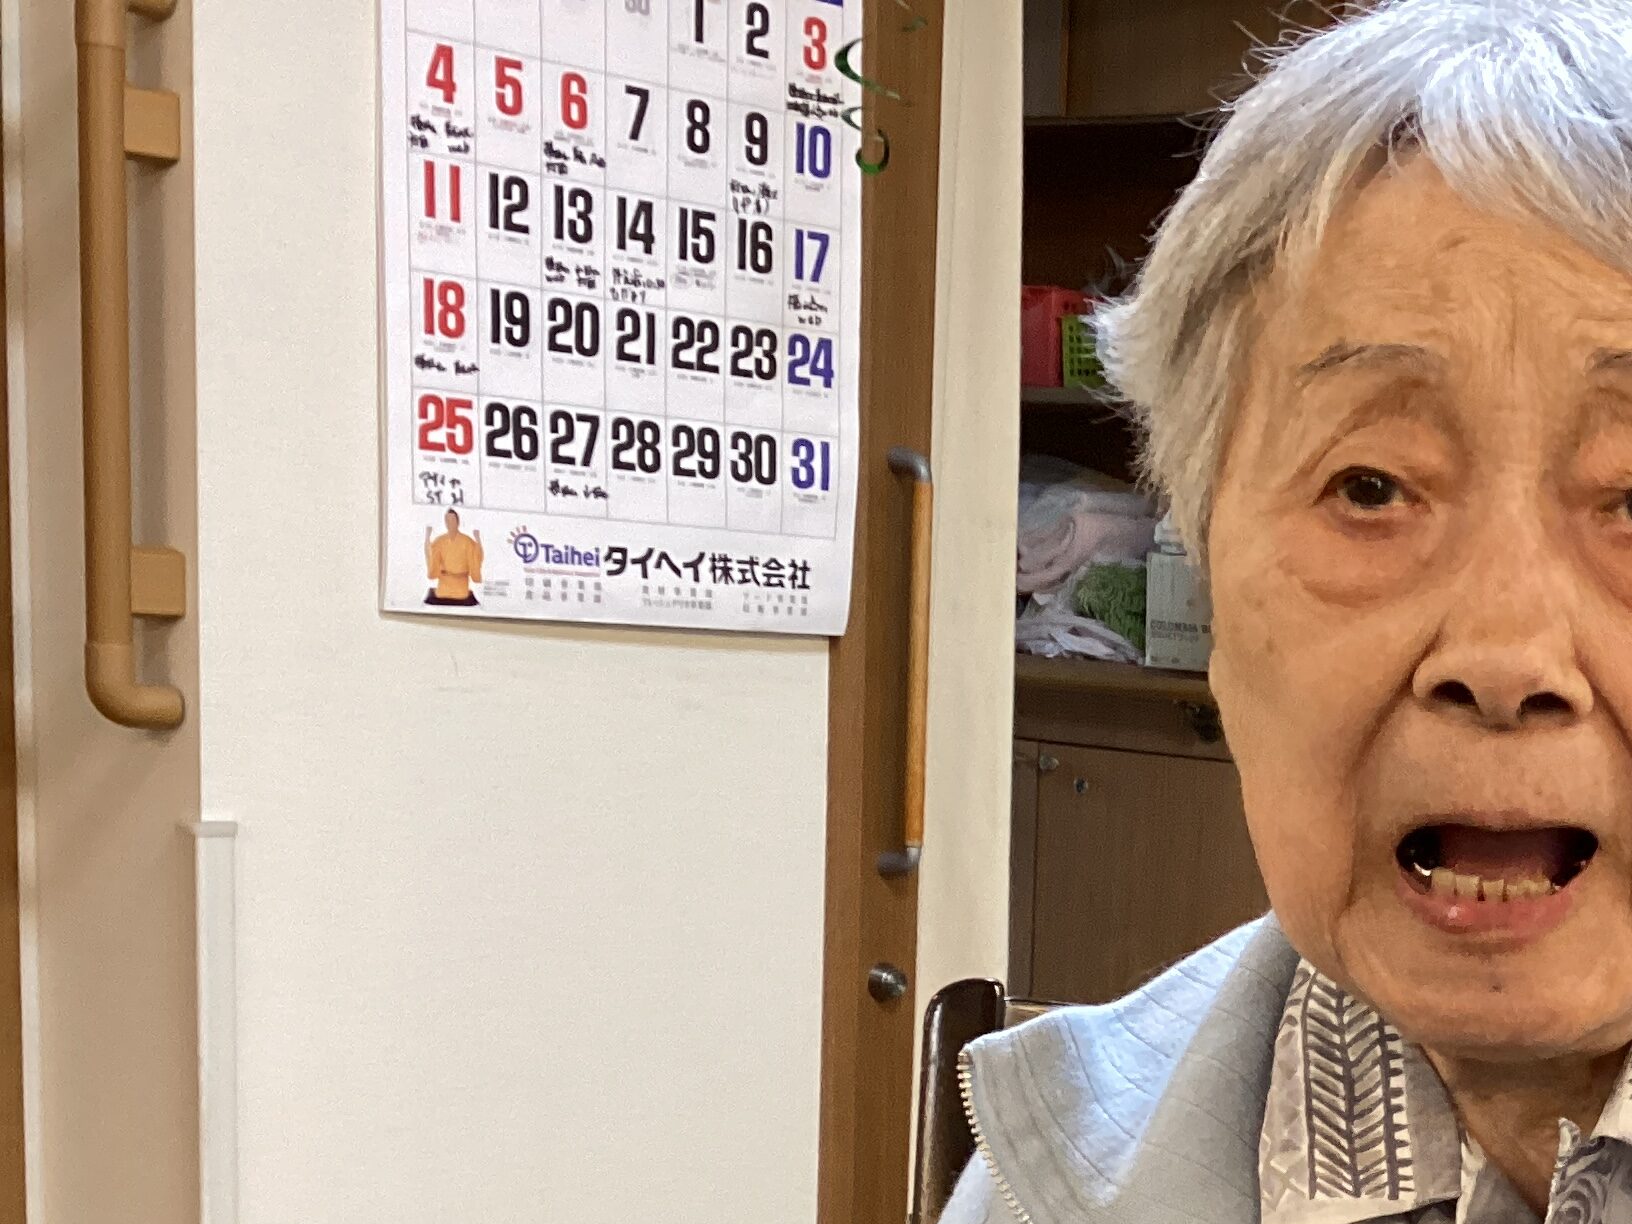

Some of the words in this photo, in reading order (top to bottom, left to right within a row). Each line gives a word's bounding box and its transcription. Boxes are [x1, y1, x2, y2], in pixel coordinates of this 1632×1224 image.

[695, 0, 704, 44] 1
[747, 2, 770, 59] 2
[804, 17, 827, 71] 3
[427, 45, 456, 104] 4
[496, 57, 523, 116] 5
[562, 73, 588, 130] 6
[626, 85, 650, 141] 7
[687, 99, 711, 154] 8
[746, 112, 769, 166] 9
[796, 122, 832, 179] 10
[425, 161, 461, 223] 11
[490, 173, 530, 235] 12
[555, 185, 593, 244] 13
[618, 196, 655, 255] 14
[679, 207, 716, 264] 15
[738, 218, 773, 274] 16
[795, 229, 830, 283] 17
[425, 278, 465, 339] 18
[491, 288, 531, 348] 19
[548, 297, 600, 358] 20
[617, 307, 656, 365] 21
[672, 316, 720, 375] 22
[731, 325, 778, 381] 23
[788, 333, 834, 389] 24
[419, 394, 474, 455] 25
[486, 402, 539, 461] 26
[550, 410, 600, 467] 27
[612, 417, 661, 474] 28
[673, 424, 721, 480] 29
[731, 431, 777, 486] 30
[792, 438, 830, 491] 31
[540, 543, 600, 567] Taihei
[604, 545, 811, 590] タイヘイ株式会社
